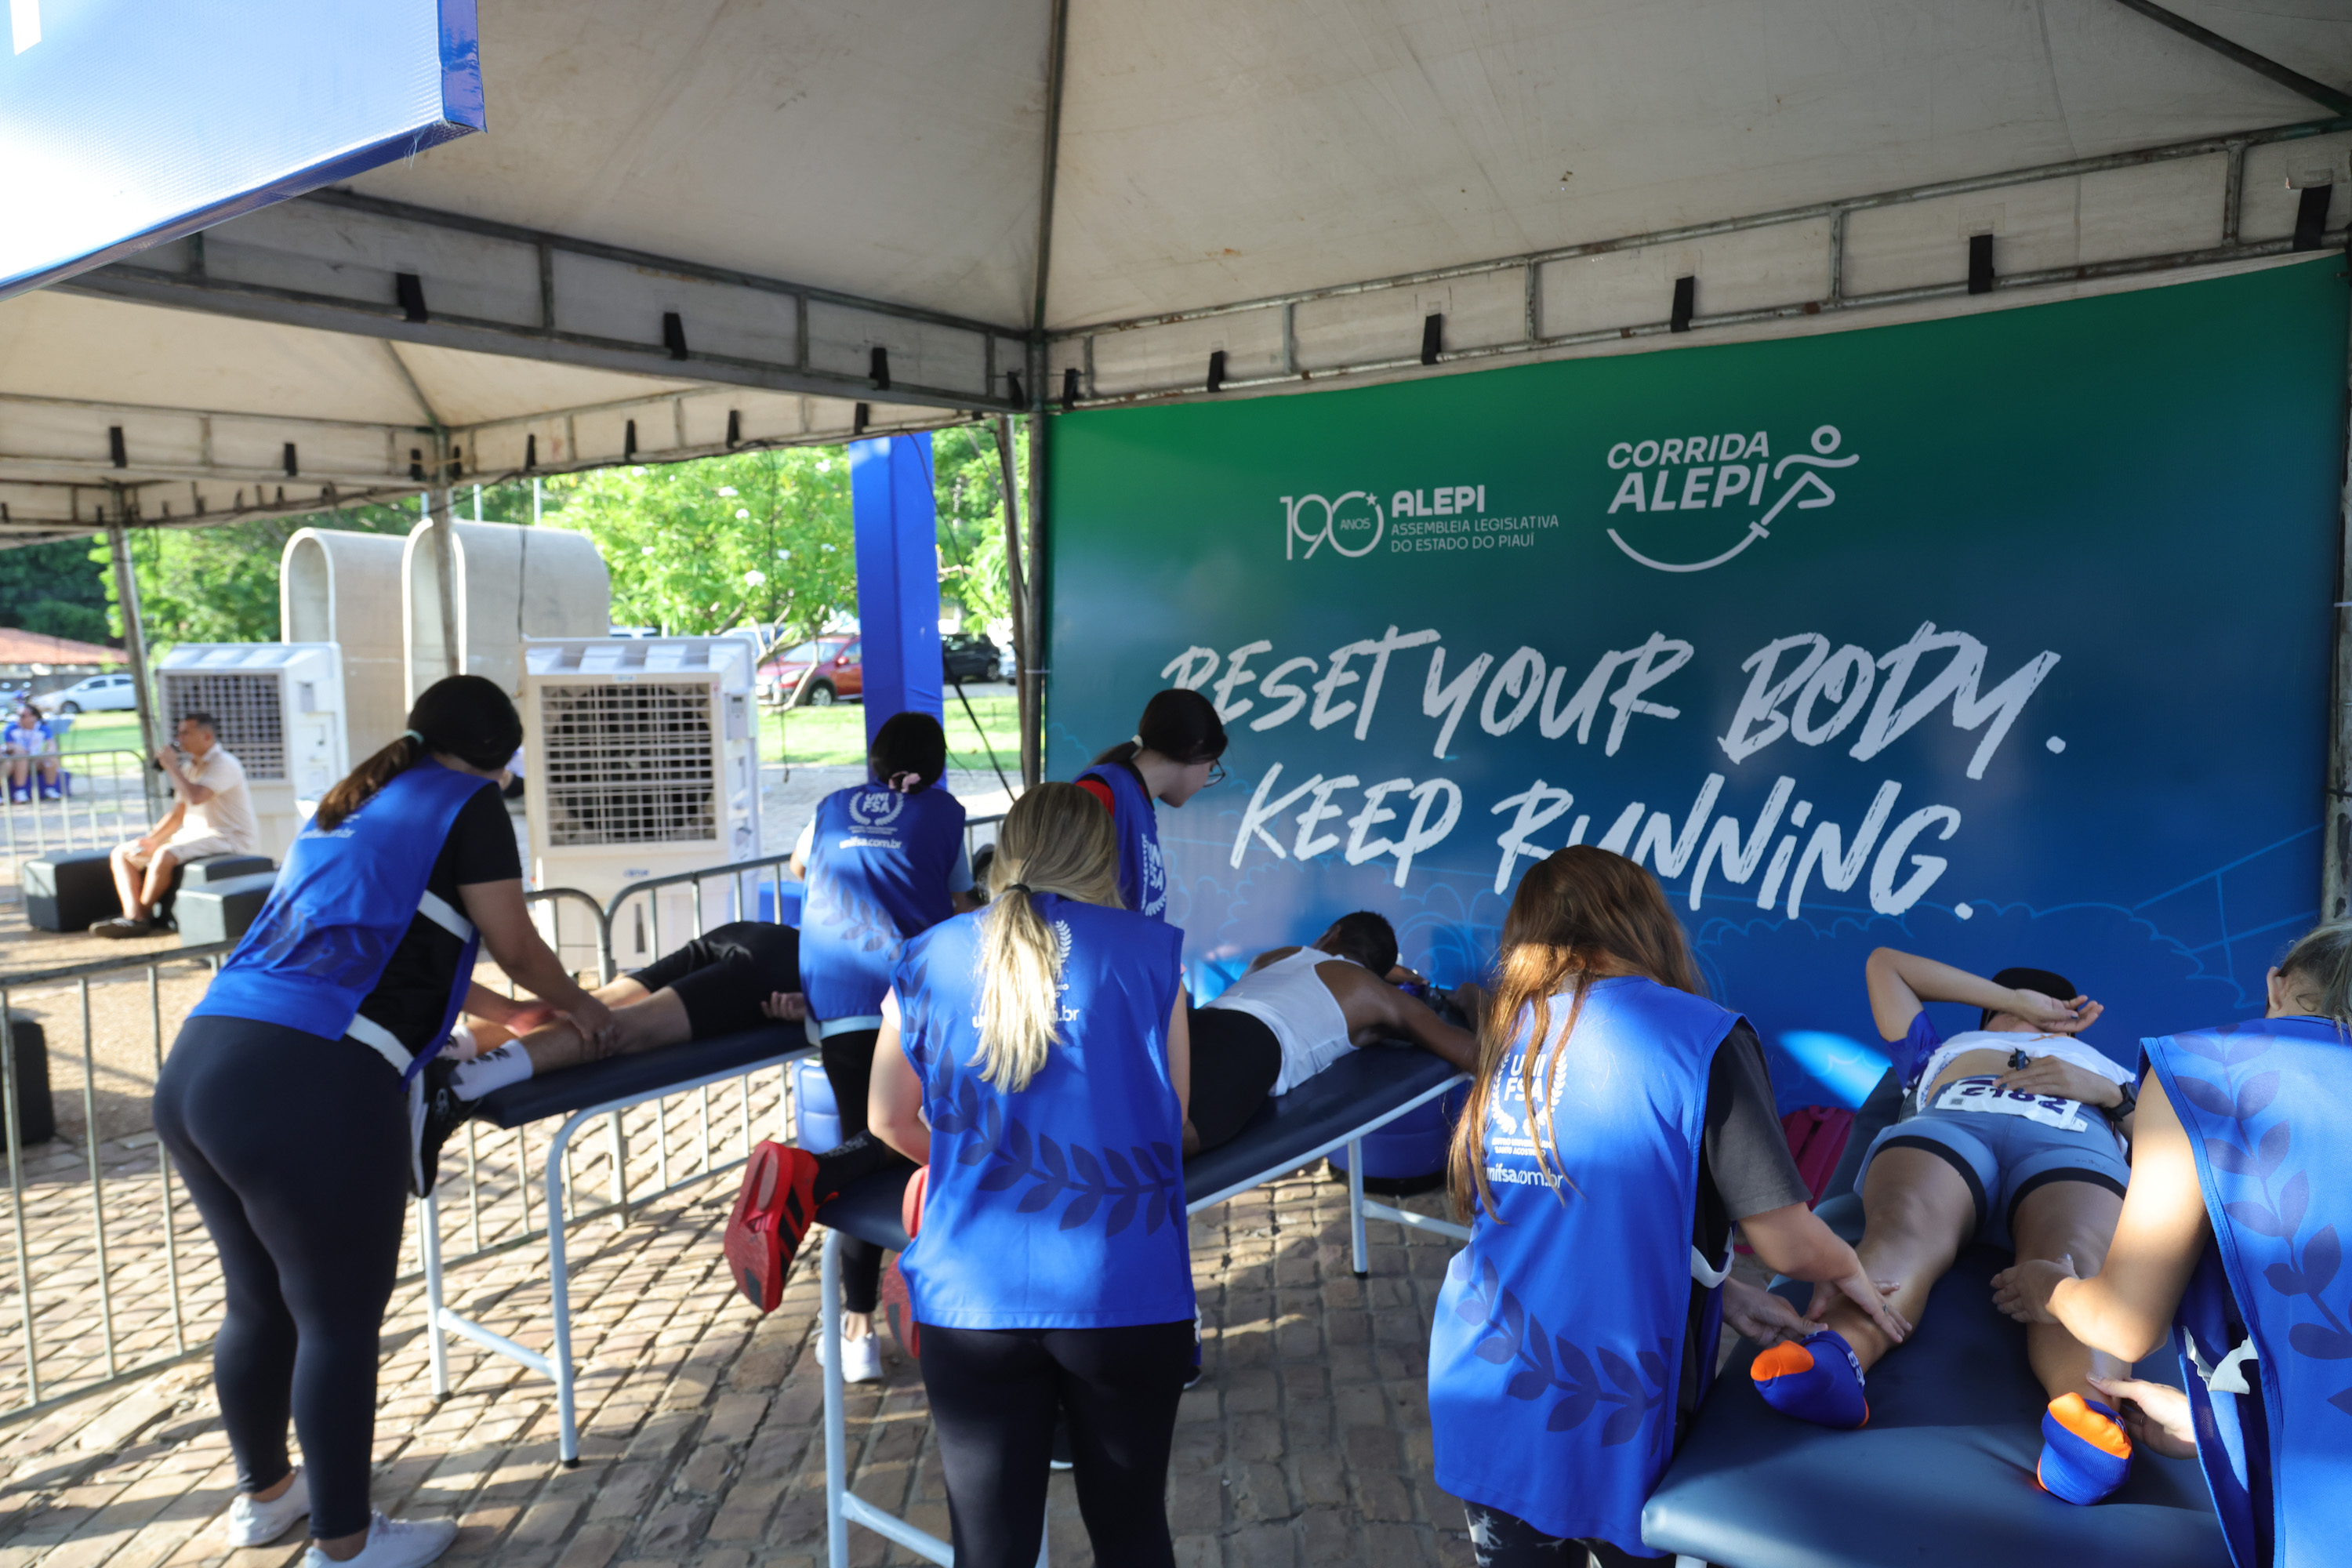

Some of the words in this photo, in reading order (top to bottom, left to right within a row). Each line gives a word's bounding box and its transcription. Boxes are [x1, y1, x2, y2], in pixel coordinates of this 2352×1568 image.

[1607, 430, 1769, 470] CORRIDA
[1392, 485, 1485, 517] ALEPI
[1607, 463, 1769, 514] ALEPI
[1279, 490, 1385, 561] 190
[1340, 517, 1371, 531] ANOS
[1391, 519, 1471, 536] ASSEMBLEIA
[1474, 514, 1559, 532] LEGISLATIVA
[1391, 539, 1412, 553] DO
[1415, 536, 1468, 552] ESTADO
[1472, 535, 1494, 550] DO
[1498, 532, 1535, 548] PIAUÍ
[1422, 630, 1694, 759] YOUR
[1229, 761, 1462, 888] KEEP
[1504, 1076, 1544, 1102] FSA
